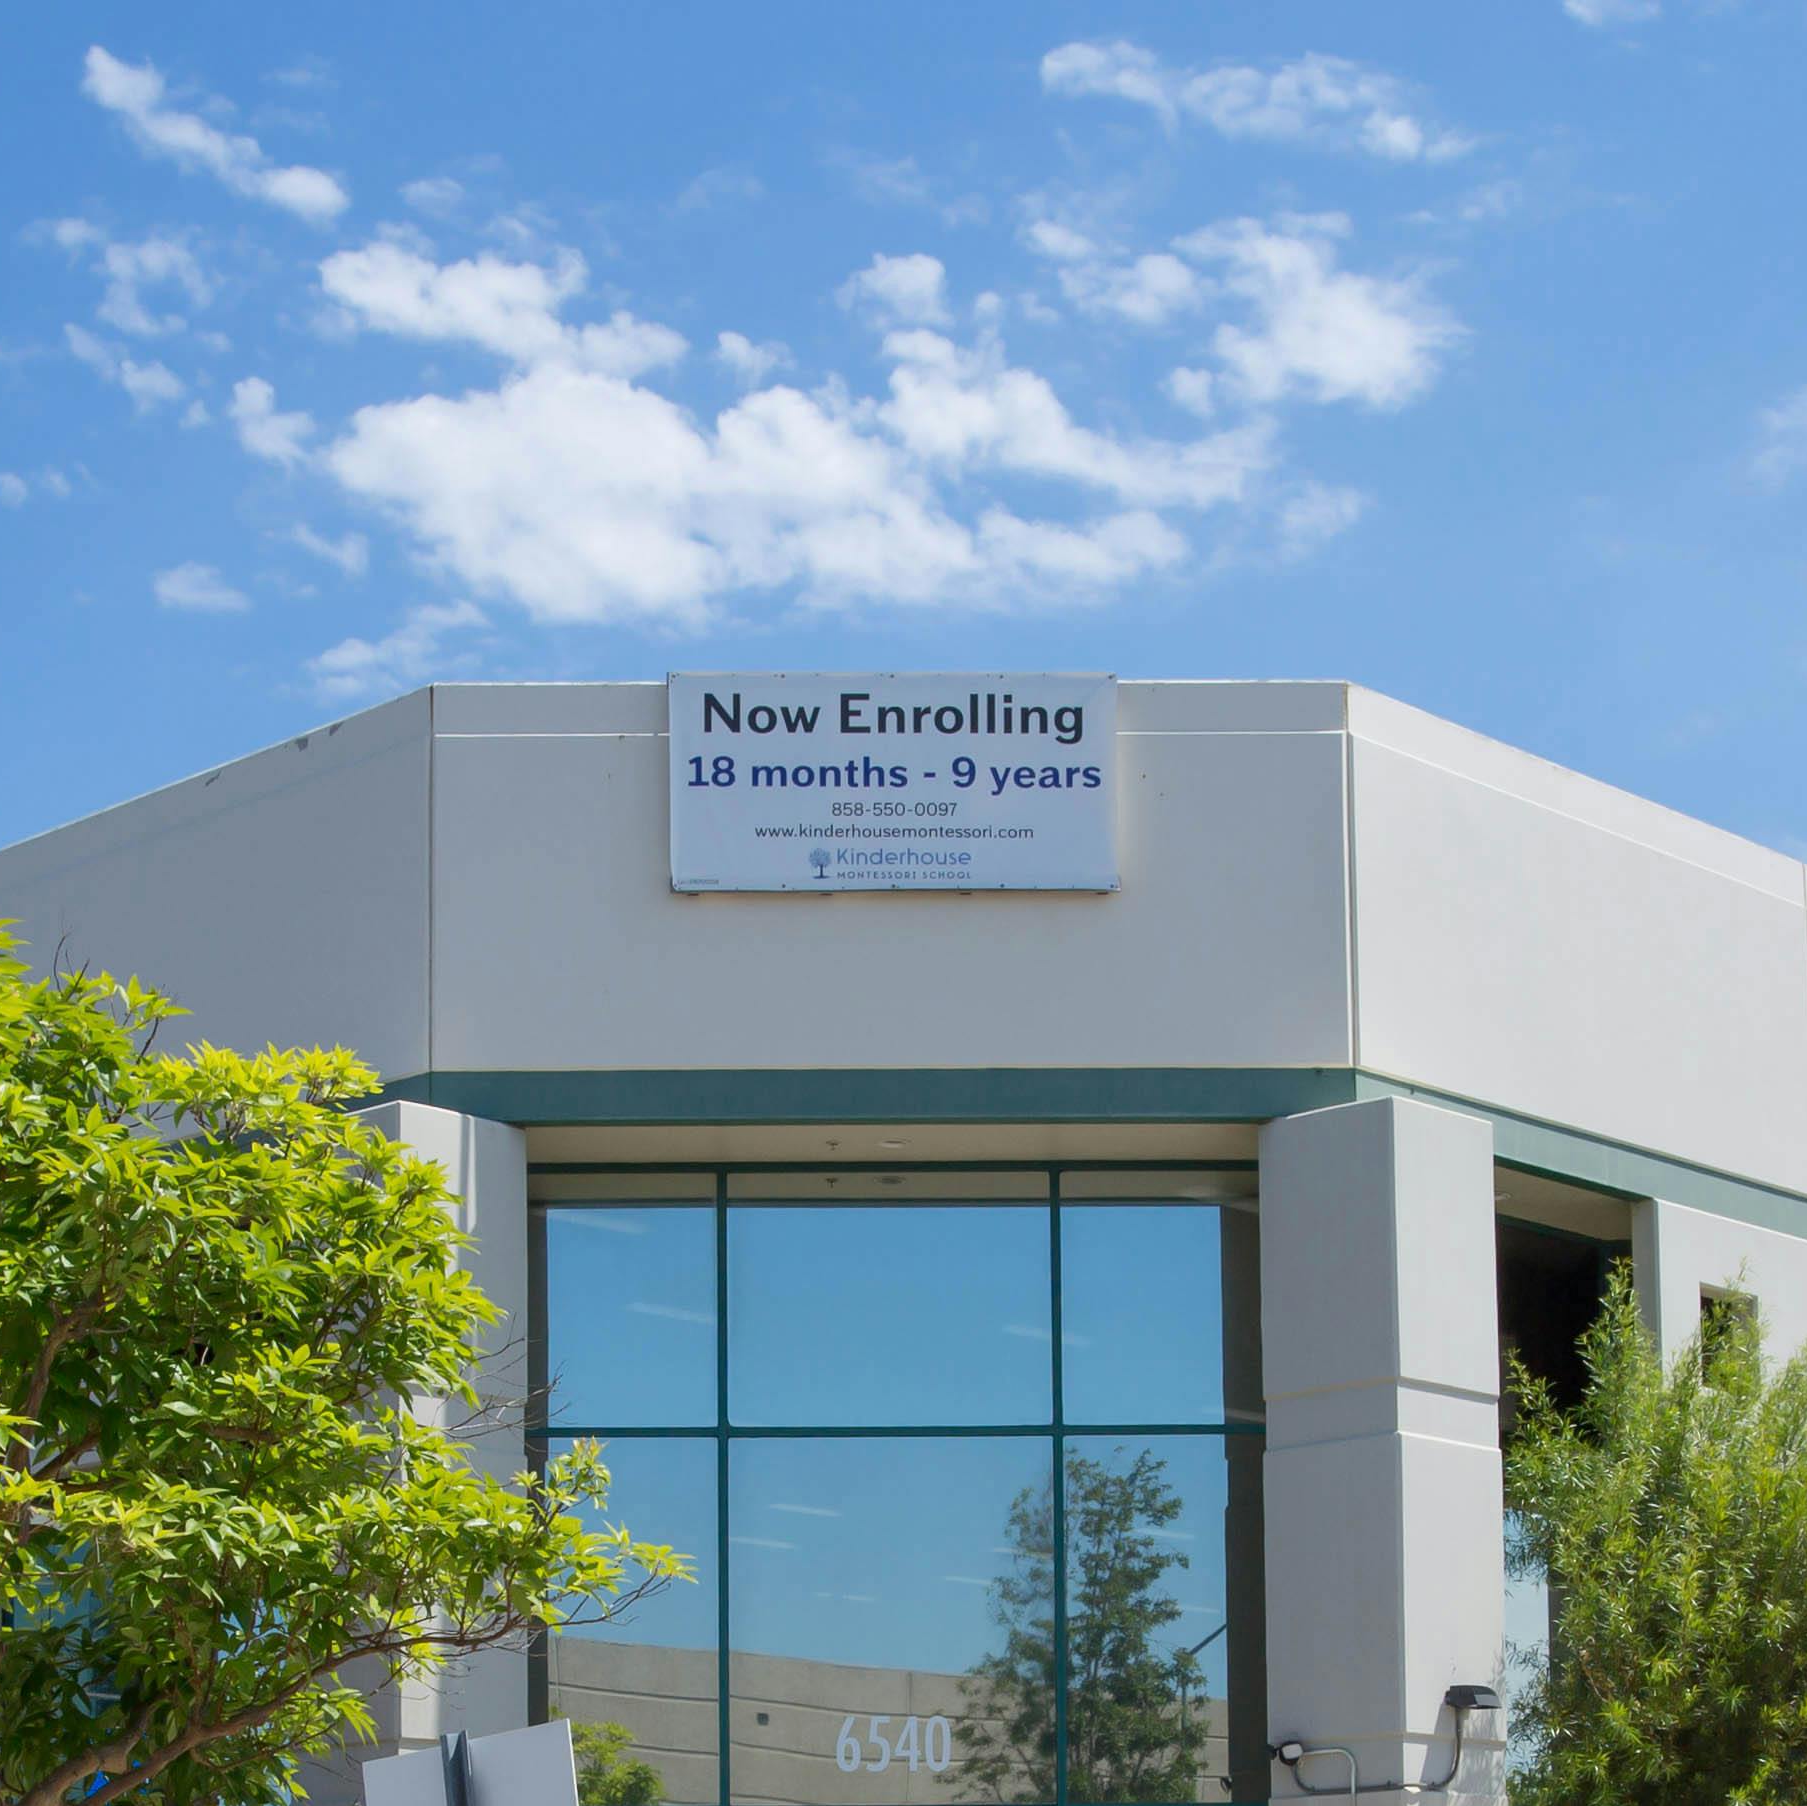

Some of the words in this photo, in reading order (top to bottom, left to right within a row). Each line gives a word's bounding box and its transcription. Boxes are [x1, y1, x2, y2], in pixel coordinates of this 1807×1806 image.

[703, 692, 821, 734] Now
[840, 692, 1084, 745] Enrolling
[687, 755, 736, 788] 18
[750, 755, 908, 788] months
[951, 755, 977, 788] 9
[989, 763, 1102, 797] years
[831, 801, 958, 817] 858-550-0097
[754, 823, 1035, 839] www.kinderhousemontessori.com
[836, 847, 973, 866] Kinderhouse
[836, 871, 917, 880] MONTESSORI
[922, 871, 972, 881] SCHOOL
[835, 1714, 952, 1773] 6540
